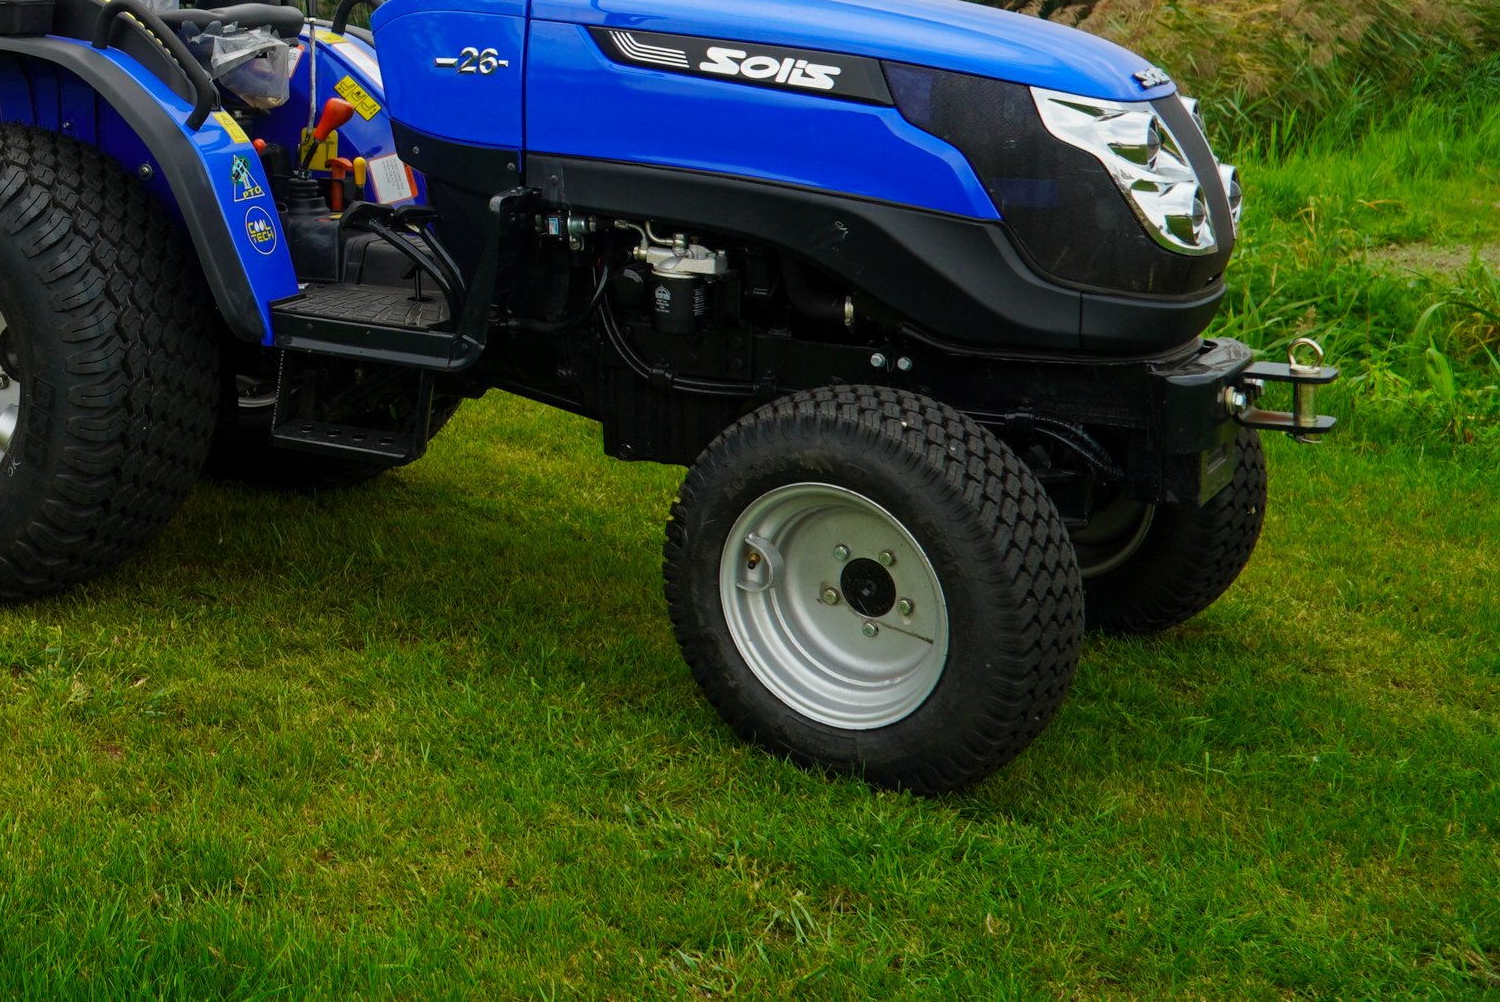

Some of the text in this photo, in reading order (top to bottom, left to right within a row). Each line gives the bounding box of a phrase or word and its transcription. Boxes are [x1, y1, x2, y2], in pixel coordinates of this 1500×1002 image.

[242, 186, 262, 200] PTO
[248, 219, 272, 234] COOL
[250, 229, 275, 244] TECH
